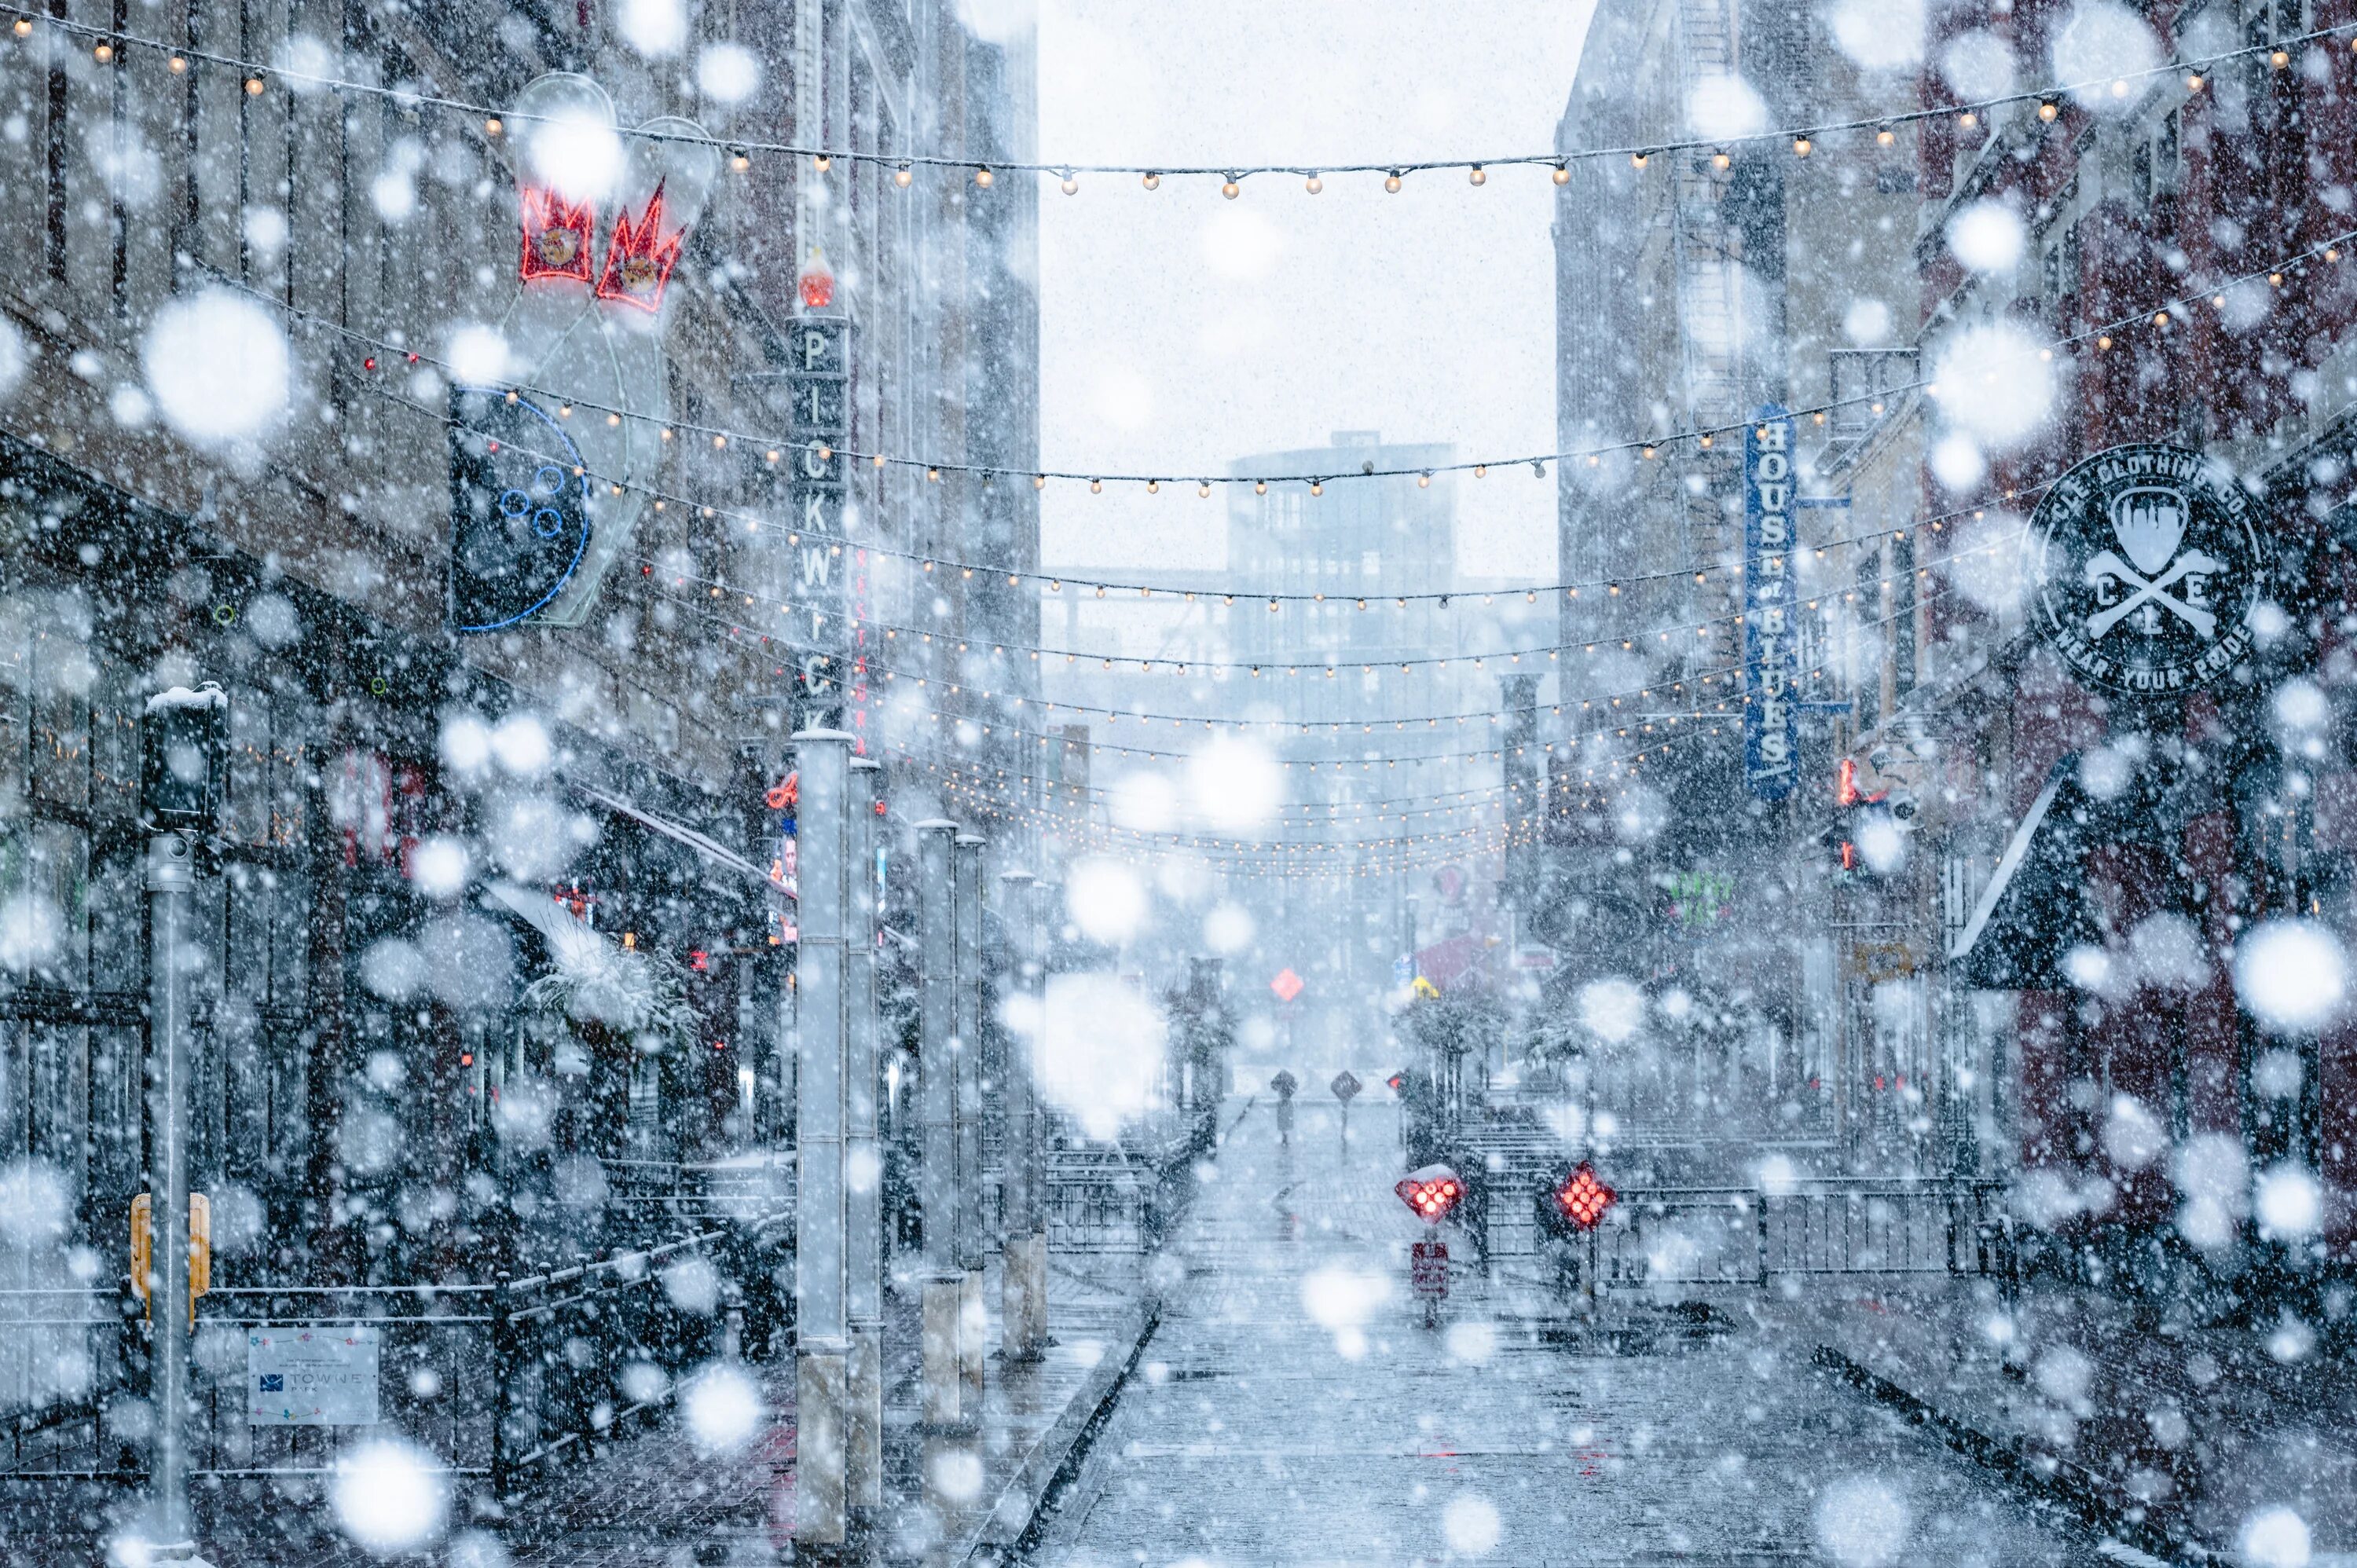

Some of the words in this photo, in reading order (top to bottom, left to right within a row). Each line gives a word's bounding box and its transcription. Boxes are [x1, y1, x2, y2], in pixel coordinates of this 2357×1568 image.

[1757, 423, 1788, 577] HOUSE
[2051, 478, 2089, 521] CLE
[2098, 455, 2207, 486] CLOTHING
[801, 331, 832, 731] PICKWICK
[1759, 581, 1783, 599] of
[856, 549, 867, 755] RESTAURA
[2055, 628, 2109, 679] WEAR
[2122, 668, 2183, 690] YOUR
[2194, 627, 2253, 680] PRIDE
[1761, 609, 1788, 762] BLUES
[602, 1170, 623, 1182] OW
[625, 1170, 674, 1185] LEASING
[289, 1373, 362, 1384] TOWNE
